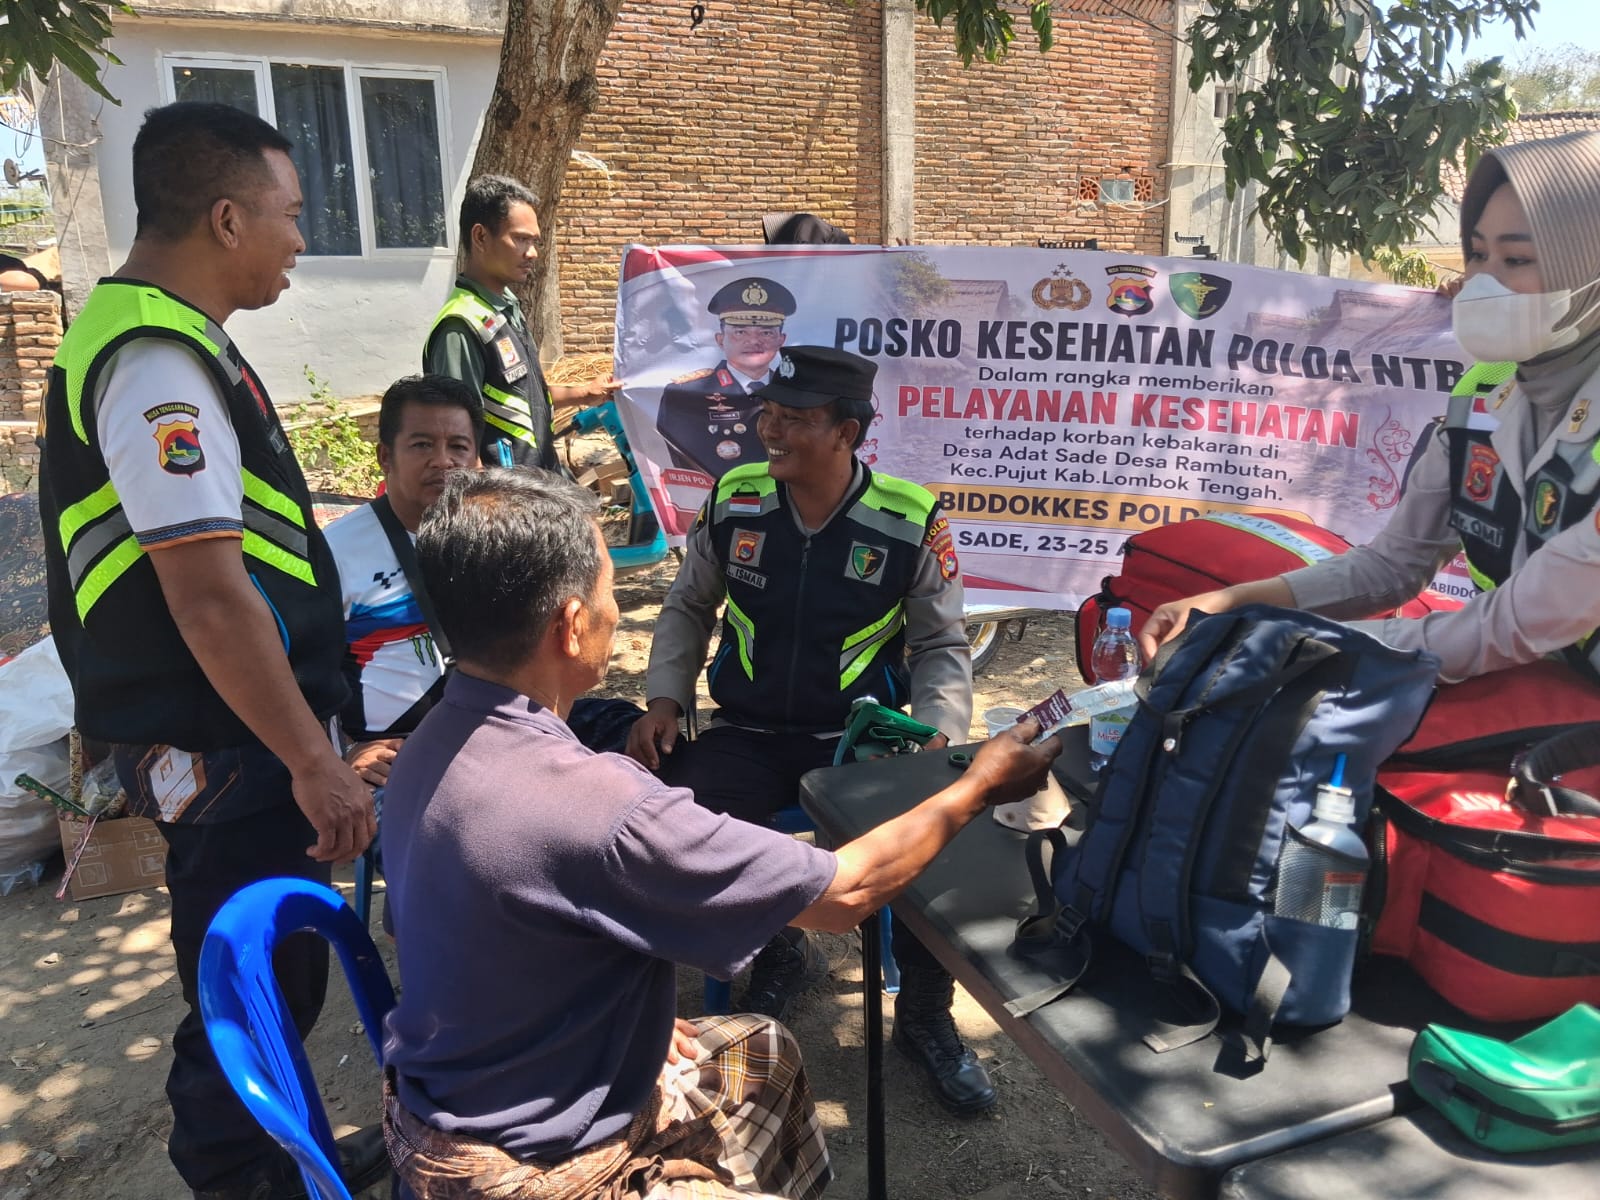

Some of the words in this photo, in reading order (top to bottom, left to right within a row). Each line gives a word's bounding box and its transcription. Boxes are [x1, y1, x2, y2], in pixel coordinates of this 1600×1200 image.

[834, 317, 962, 359] POSKO
[977, 320, 1216, 369] KESEHATAN
[1228, 334, 1365, 384] POLDA
[1371, 353, 1467, 393] NTB
[978, 366, 1048, 383] Dalam
[1056, 369, 1130, 388] rangka
[1139, 374, 1274, 397] memberikan
[897, 385, 1120, 425] PELAYANAN
[1130, 392, 1360, 448] KESEHATAN
[964, 426, 1056, 444] terhadap
[1063, 428, 1135, 447] korban
[1142, 432, 1253, 456] kebakaran
[1259, 442, 1280, 459] di
[943, 443, 993, 459] Desa
[999, 445, 1049, 462] Adat
[1055, 448, 1108, 465] Sade
[1115, 450, 1167, 469] Desa
[1175, 456, 1293, 483] Rambutan,
[950, 463, 1047, 483] Kec.Pujut
[1054, 468, 1189, 491] Kab.Lombok
[1197, 478, 1284, 501] Tengah.
[939, 490, 1109, 521] BIDDOKKES
[1118, 501, 1200, 526] POLD
[957, 530, 1029, 552] SADE,
[1037, 535, 1108, 555] 23-25
[735, 567, 766, 588] ISMAIL
[1430, 581, 1477, 600] ABIDDO
[1097, 731, 1121, 741] Miner
